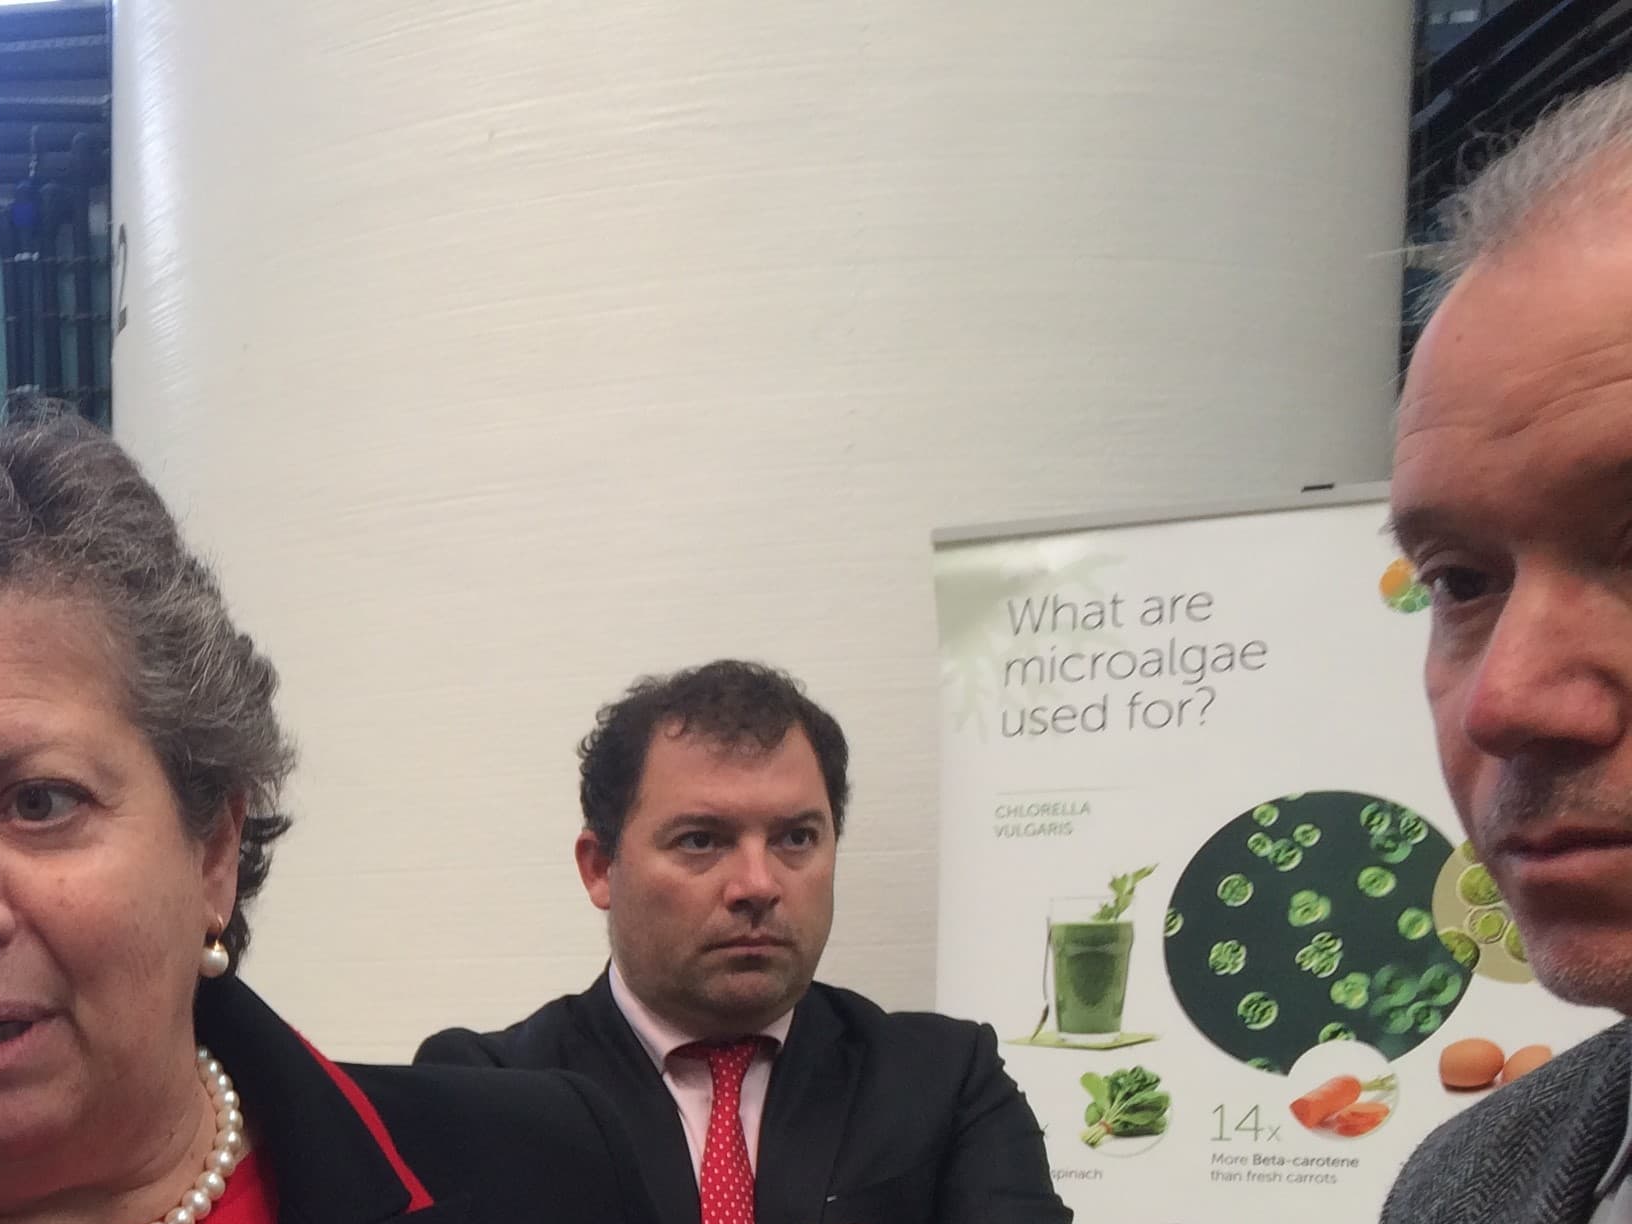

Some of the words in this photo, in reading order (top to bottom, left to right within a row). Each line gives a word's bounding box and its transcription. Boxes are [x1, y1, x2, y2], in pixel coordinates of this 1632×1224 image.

[1006, 593, 1124, 637] What
[1139, 591, 1214, 627] are
[1003, 637, 1269, 688] microalgae
[1001, 693, 1108, 738] used
[1126, 685, 1217, 731] for?
[994, 801, 1090, 819] CHLORELLA
[993, 821, 1073, 838] VULGARIS
[1211, 1153, 1248, 1167] More
[1252, 1153, 1360, 1169] Beta-carotene
[1050, 1167, 1103, 1182] spinach
[1210, 1170, 1242, 1183] than
[1246, 1170, 1282, 1184] fresh
[1286, 1173, 1337, 1185] carrots
